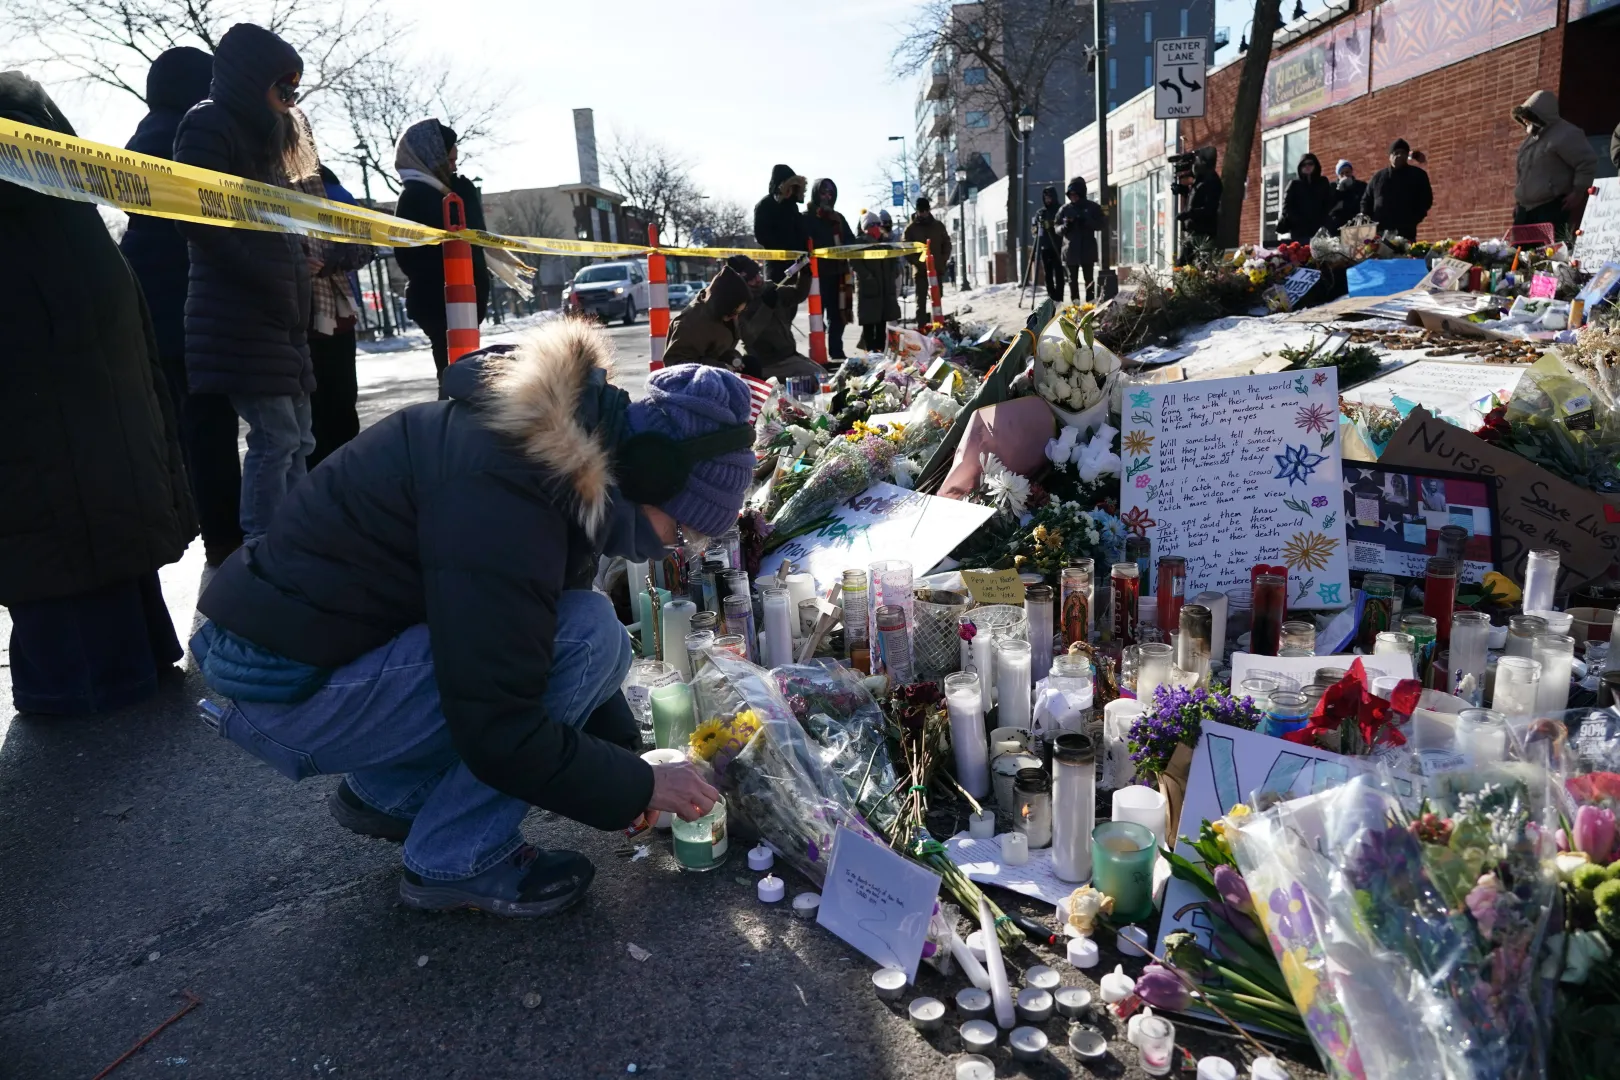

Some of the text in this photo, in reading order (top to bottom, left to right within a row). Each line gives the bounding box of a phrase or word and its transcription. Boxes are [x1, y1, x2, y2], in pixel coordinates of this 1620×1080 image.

[1162, 42, 1200, 52] CENTER
[1168, 52, 1194, 61] LANE
[1168, 106, 1191, 115] ONLY
[28, 149, 65, 190] NOT
[60, 156, 86, 194] DO
[81, 162, 114, 199] LINE
[112, 169, 151, 206] POLICE
[198, 187, 228, 219] CROSS
[227, 194, 246, 221] NOT
[1162, 395, 1176, 408] All
[1183, 393, 1200, 402] these
[1208, 388, 1228, 401] people
[1247, 384, 1260, 393] the
[1268, 380, 1292, 391] world
[1161, 406, 1181, 417] Going
[1202, 401, 1219, 410] with
[1228, 397, 1247, 406] their
[1190, 412, 1206, 422] they
[1210, 408, 1227, 425] just
[1232, 404, 1264, 414] murdered
[1175, 422, 1193, 430] front
[1200, 418, 1209, 427] of
[1220, 417, 1232, 425] my
[1237, 413, 1257, 424] eyes
[1160, 447, 1174, 457] Will
[1182, 446, 1197, 457] they
[1203, 443, 1226, 451] watch
[1247, 436, 1283, 448] someday
[1161, 427, 1275, 449] Will somebody tell them
[1160, 456, 1175, 466] Will
[1181, 456, 1197, 466] they
[1200, 453, 1216, 461] also
[1222, 450, 1234, 460] get
[1161, 465, 1177, 473] What
[1195, 459, 1230, 469] witnessed
[1240, 454, 1264, 464] today
[1159, 479, 1174, 488] And
[1181, 477, 1188, 485] if
[1228, 470, 1240, 478] the
[1408, 421, 1620, 549] Nurses Save Lives
[1158, 497, 1174, 505] Will
[1202, 490, 1224, 498] video
[1216, 496, 1234, 504] than
[1157, 519, 1171, 528] Do
[1182, 518, 1196, 527] any
[1220, 508, 1242, 518] them
[1200, 521, 1220, 529] could
[1250, 515, 1273, 523] them
[1157, 535, 1179, 543] That
[1188, 532, 1209, 542] being
[1251, 522, 1267, 530] this
[1276, 517, 1303, 527] world
[1157, 530, 1280, 556] Might lead to their death
[1543, 528, 1572, 553] Here
[1184, 556, 1206, 567] going
[1213, 550, 1222, 558] to
[1227, 557, 1245, 565] take
[1253, 553, 1279, 562] stand
[1189, 580, 1209, 591] they
[1216, 576, 1252, 586] murdere
[1198, 568, 1236, 579] for the
[1580, 723, 1607, 737] 90%
